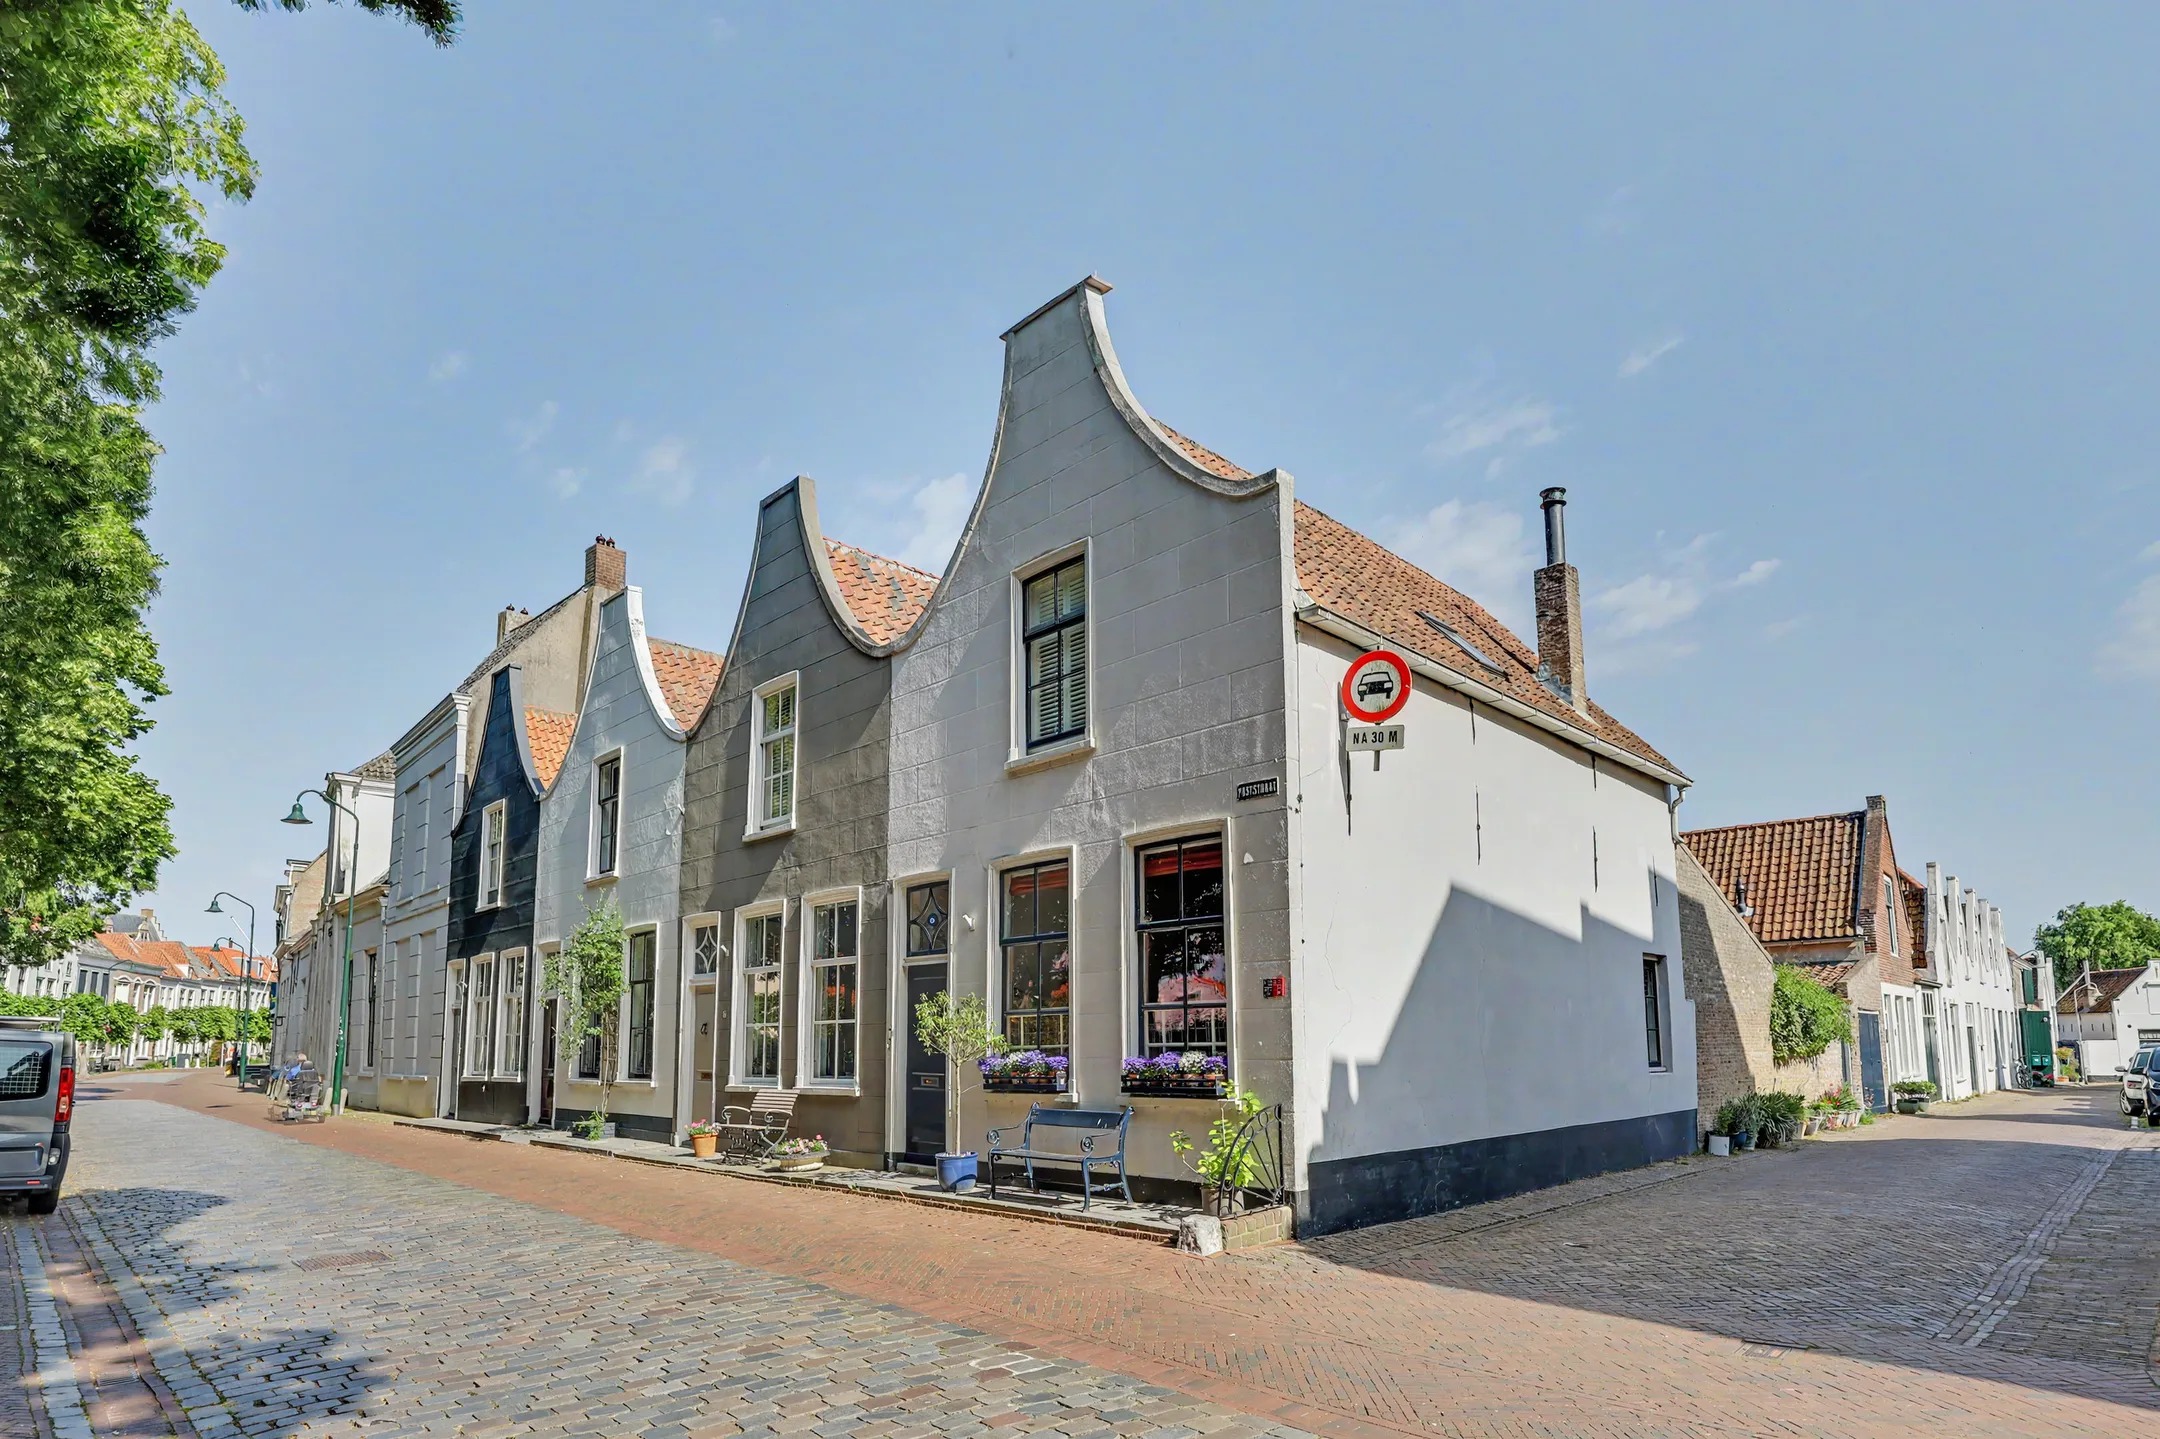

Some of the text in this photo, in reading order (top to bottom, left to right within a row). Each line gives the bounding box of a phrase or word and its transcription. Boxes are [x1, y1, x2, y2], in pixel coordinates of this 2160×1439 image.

[1353, 730, 1398, 745] NA 30 M
